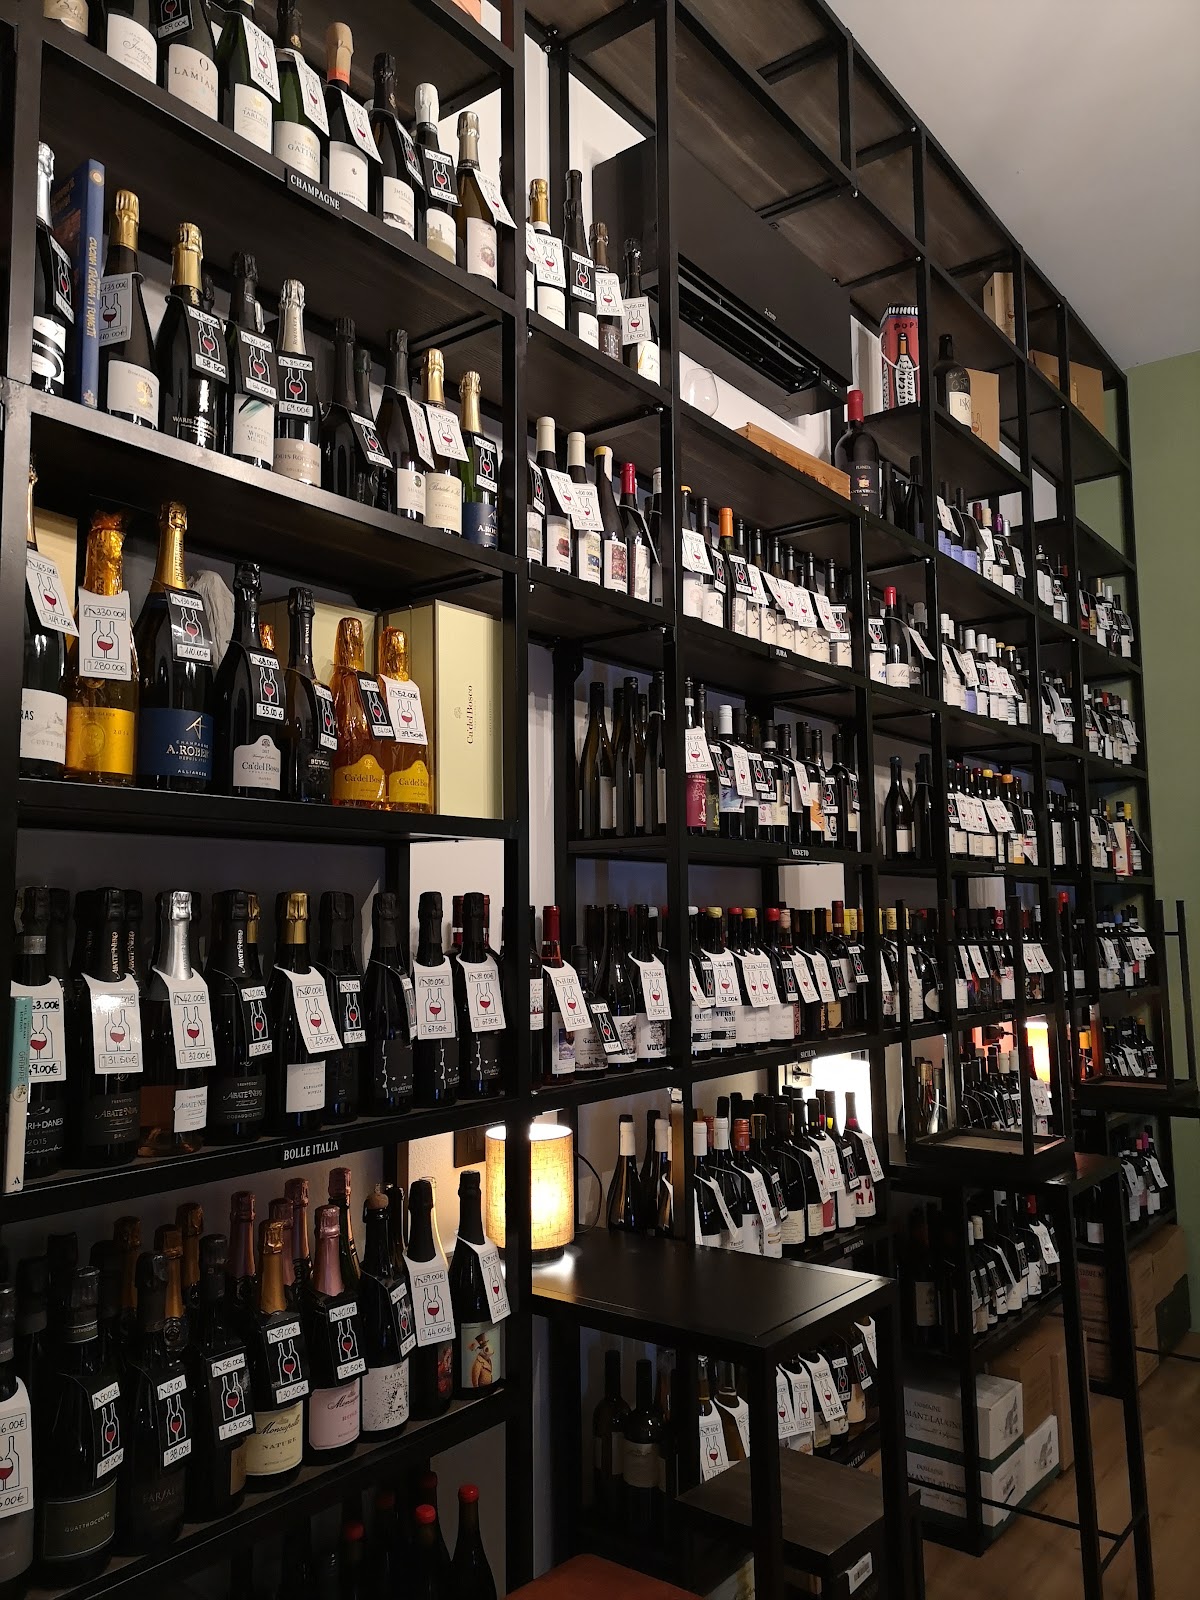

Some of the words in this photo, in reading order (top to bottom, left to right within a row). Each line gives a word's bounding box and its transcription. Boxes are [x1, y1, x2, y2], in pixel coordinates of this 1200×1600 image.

[290, 174, 341, 211] CHAMPAGNE
[95, 607, 126, 618] 330.00€
[94, 663, 125, 674] 280.00€
[800, 1049, 817, 1059] SICILIA
[283, 1145, 311, 1162] BOLLE
[312, 1140, 339, 1156] ITALIA
[261, 1437, 297, 1452] NATURE
